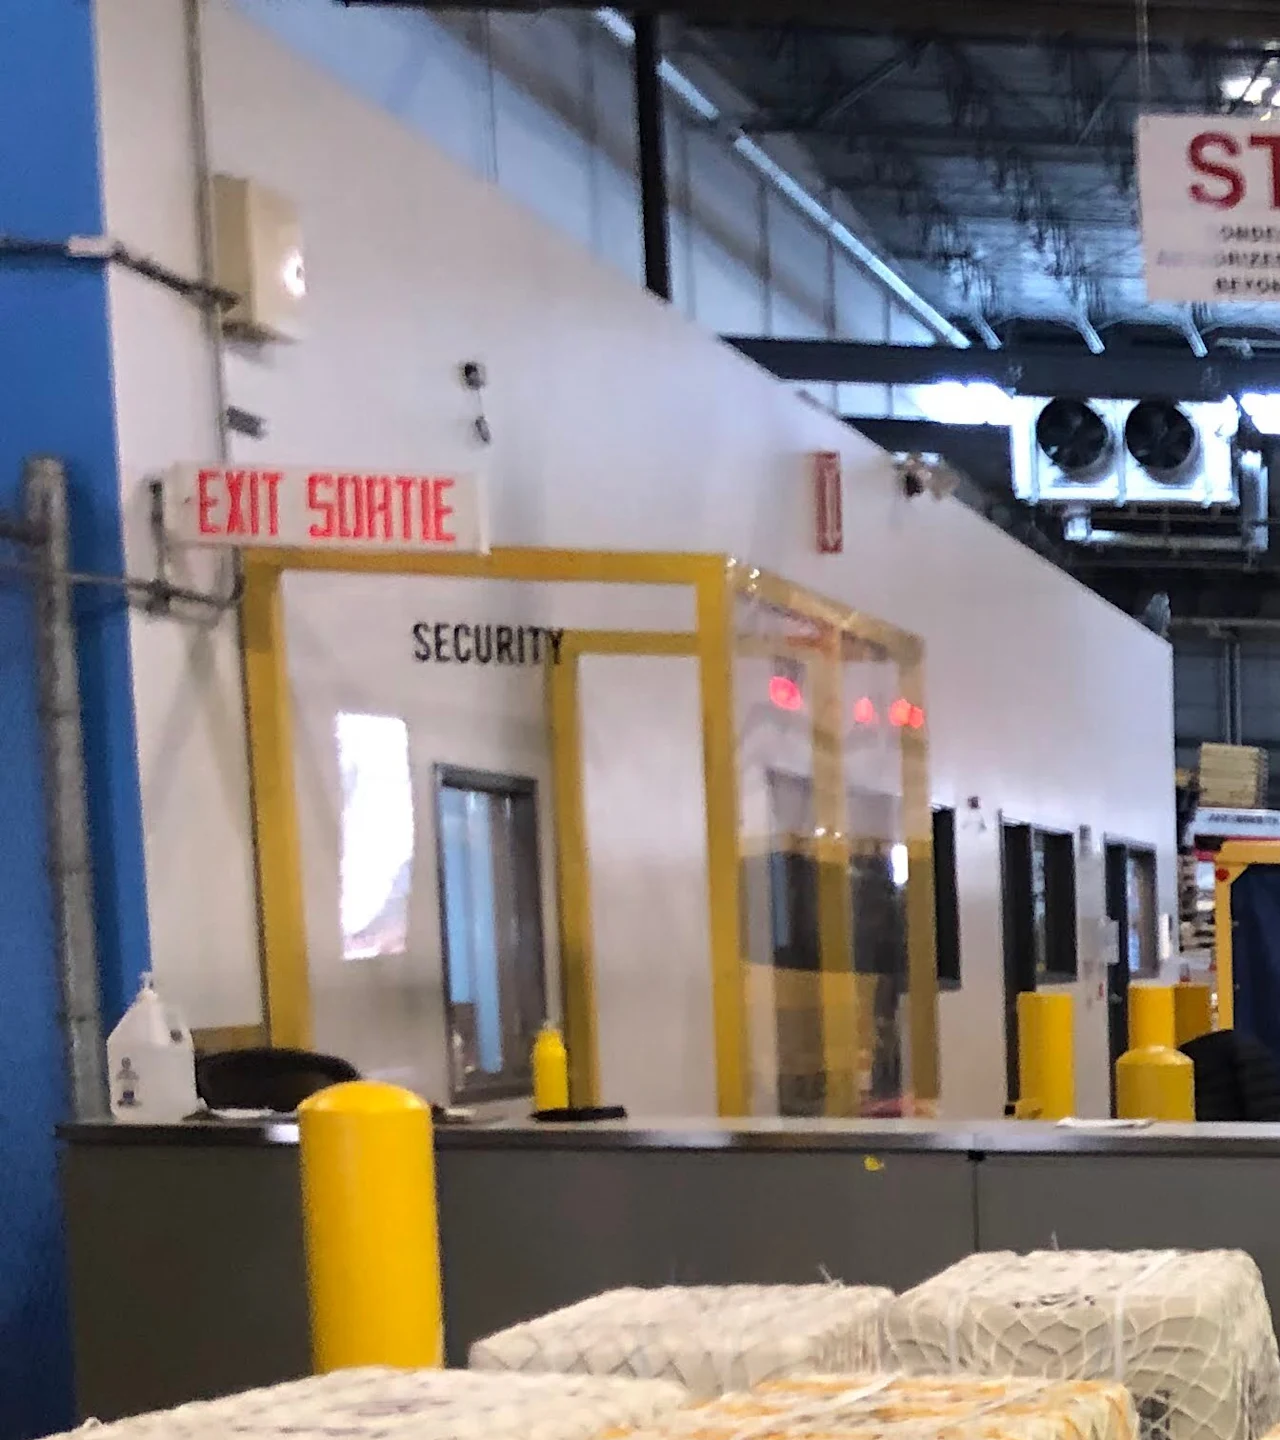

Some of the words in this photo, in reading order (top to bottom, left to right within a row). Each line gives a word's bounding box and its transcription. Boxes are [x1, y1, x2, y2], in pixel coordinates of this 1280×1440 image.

[197, 469, 283, 536] EXIT
[307, 472, 456, 543] SORTIE
[411, 621, 564, 665] SECURITY
